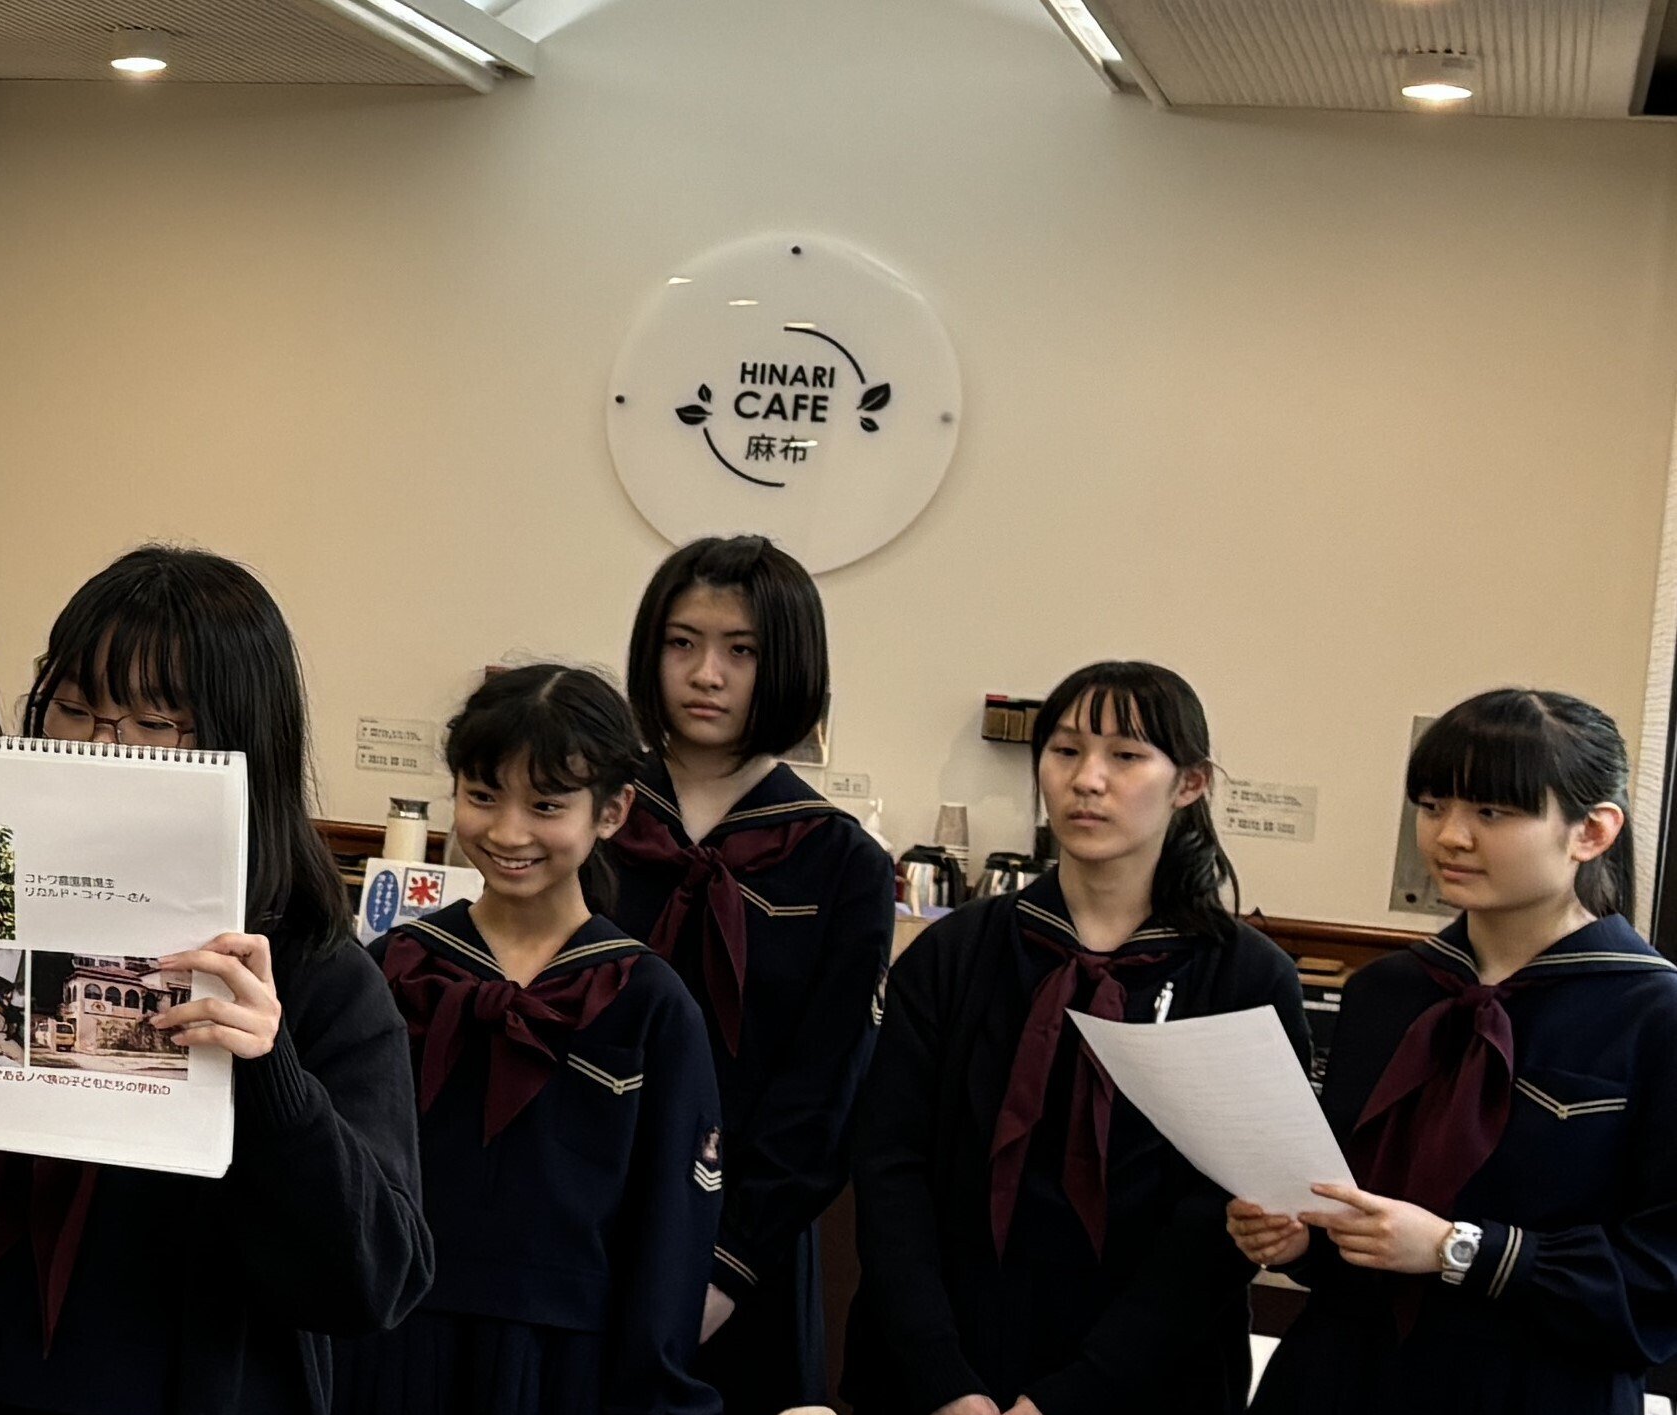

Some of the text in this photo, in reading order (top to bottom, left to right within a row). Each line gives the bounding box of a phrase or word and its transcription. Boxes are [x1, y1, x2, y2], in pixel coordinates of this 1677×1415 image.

[740, 362, 836, 389] HINARI
[733, 390, 830, 423] CAFE
[745, 433, 809, 464] 麻布
